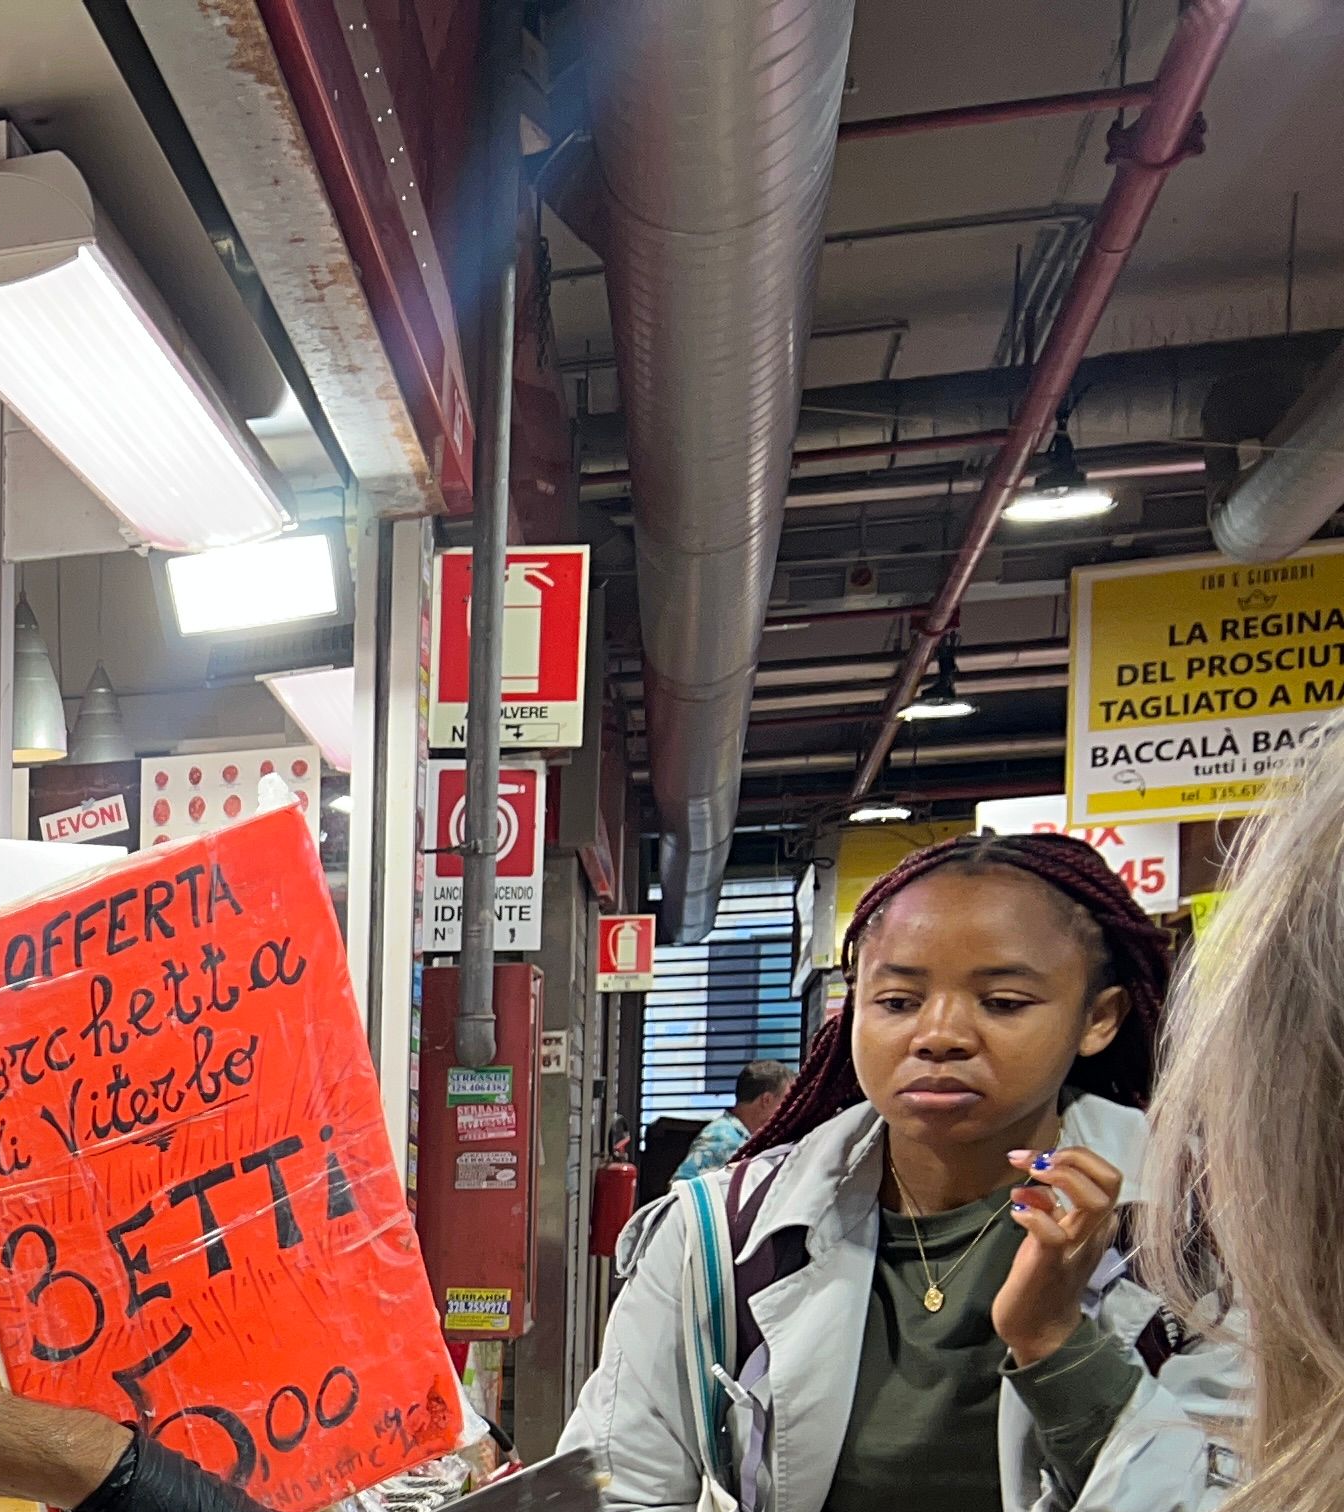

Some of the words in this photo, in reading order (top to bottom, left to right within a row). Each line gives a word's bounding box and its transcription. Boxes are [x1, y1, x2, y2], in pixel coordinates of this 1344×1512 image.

[1168, 622, 1208, 647] LA
[1220, 608, 1344, 642] REGINA
[1117, 661, 1175, 686] DEL
[500, 706, 548, 719] LVERE
[1099, 687, 1258, 723] TAGLIATO
[1269, 684, 1292, 707] A
[1091, 728, 1239, 768] BACCALÀ
[1193, 759, 1236, 777] tutti
[45, 803, 123, 842] LEVONI
[3, 863, 244, 992] OFFERTA
[40, 1024, 260, 1160] Viterbo
[0, 1222, 105, 1362] 3
